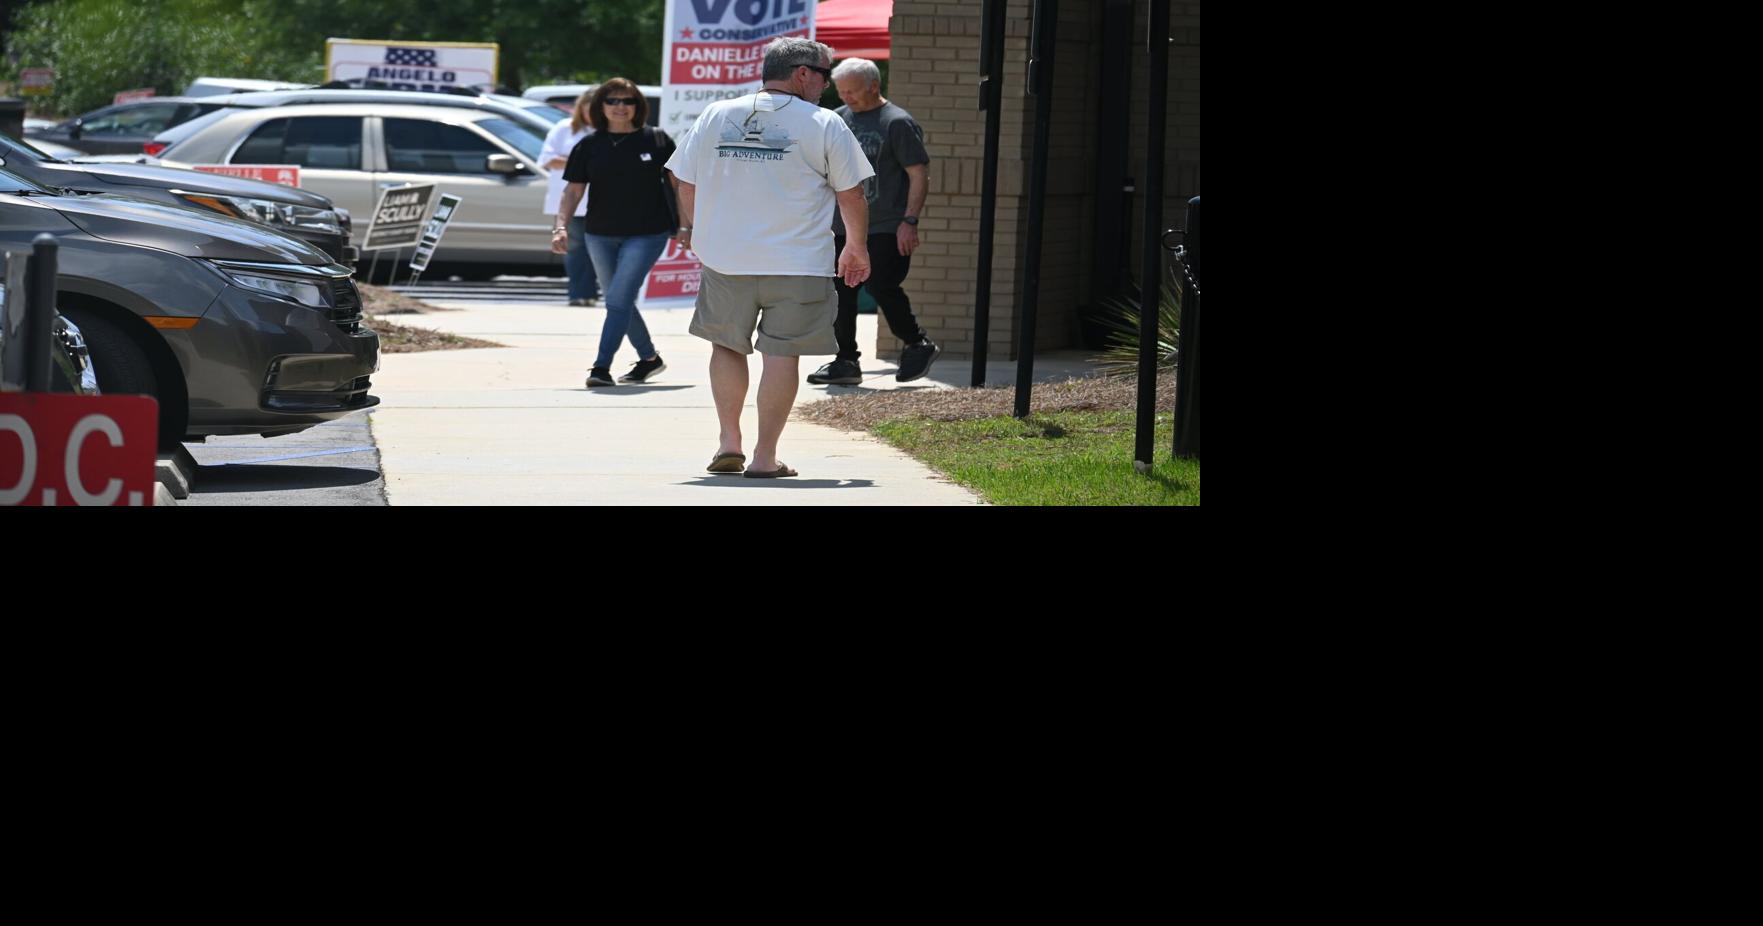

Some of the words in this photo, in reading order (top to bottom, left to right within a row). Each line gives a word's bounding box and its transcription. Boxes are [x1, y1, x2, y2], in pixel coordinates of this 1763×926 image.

[676, 46, 760, 62] DANIELLE
[367, 67, 456, 83] ANGELO
[692, 64, 720, 79] ON
[725, 63, 755, 79] THE
[732, 151, 784, 161] ADVENTURE
[376, 204, 427, 224] SCULLY
